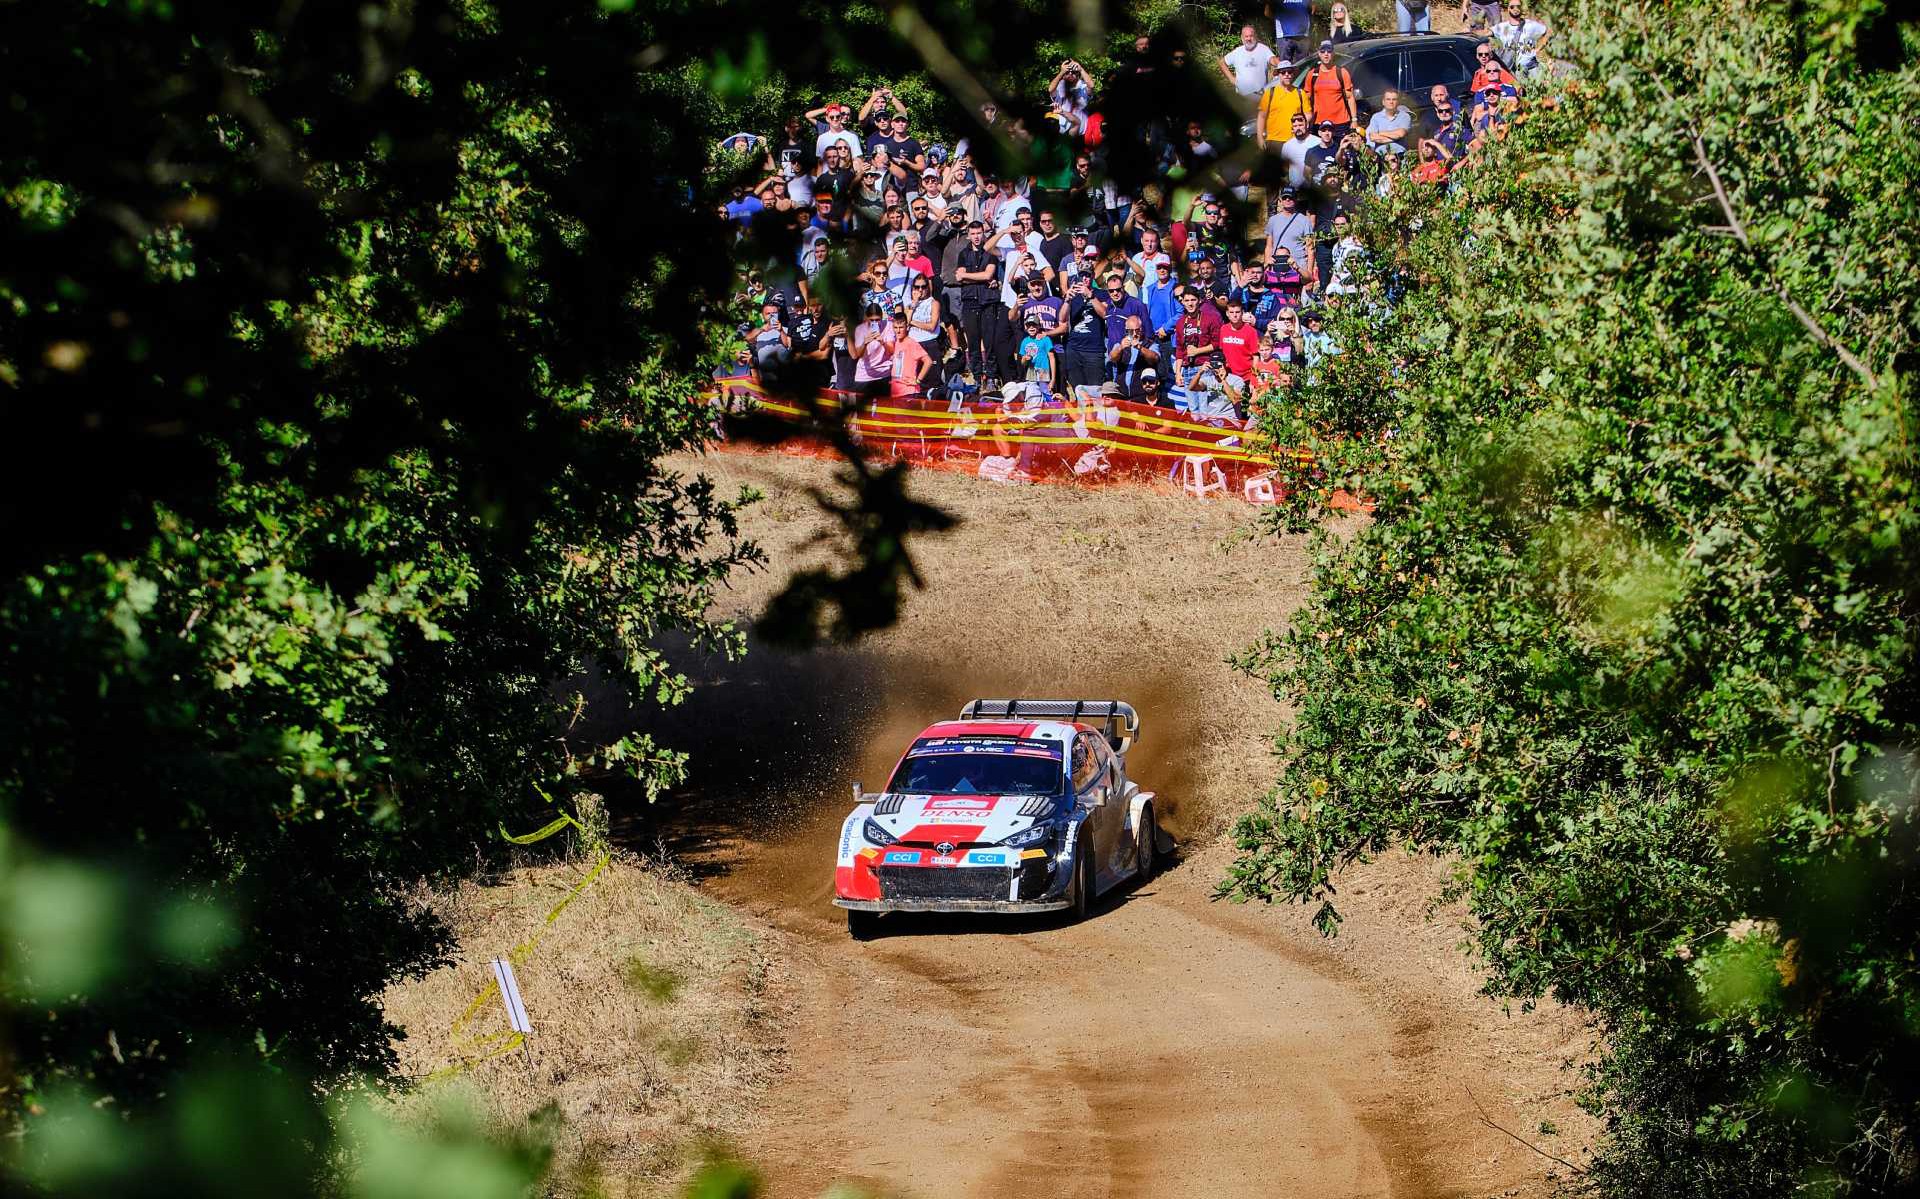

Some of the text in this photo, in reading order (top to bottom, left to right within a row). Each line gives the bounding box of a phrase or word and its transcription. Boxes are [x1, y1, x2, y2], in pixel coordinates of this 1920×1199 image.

[919, 810, 992, 818] DENSO
[842, 816, 860, 859] Panasonic
[892, 853, 913, 862] CCI
[977, 854, 997, 862] CCI
